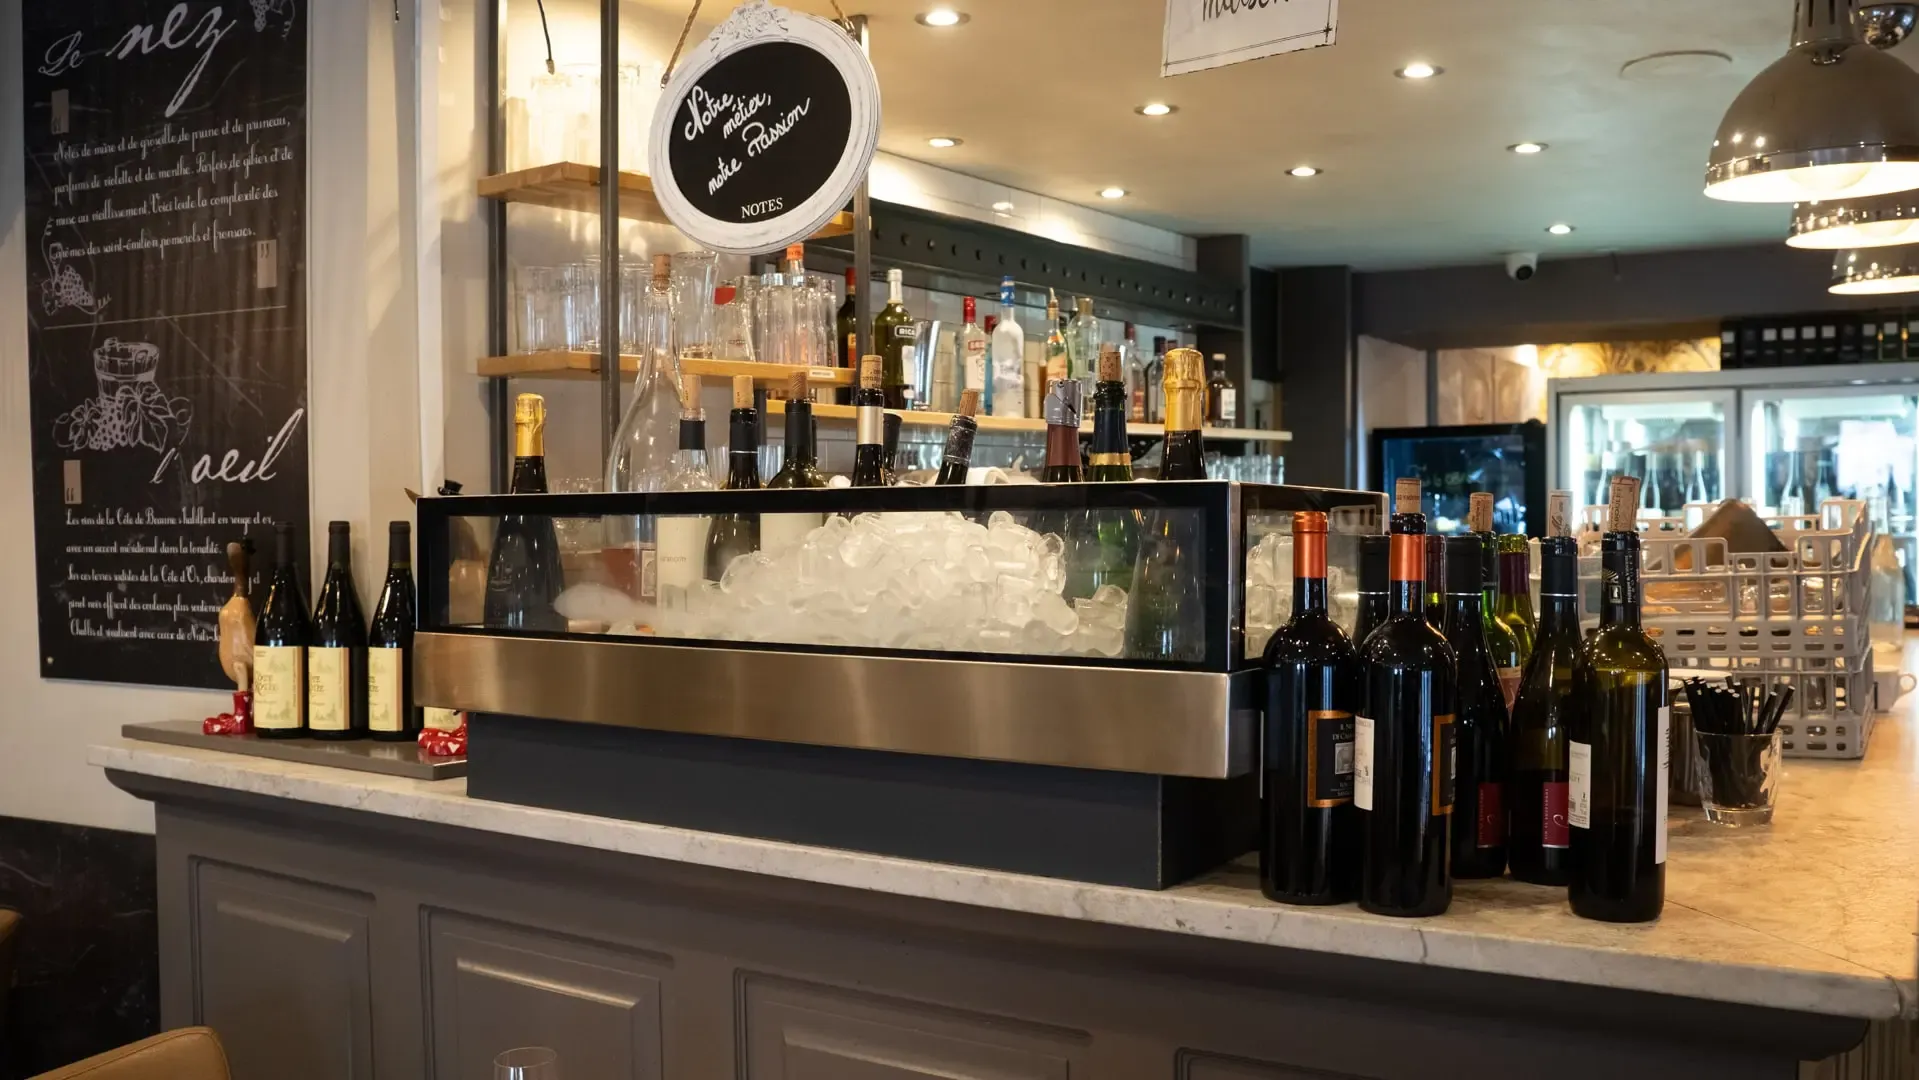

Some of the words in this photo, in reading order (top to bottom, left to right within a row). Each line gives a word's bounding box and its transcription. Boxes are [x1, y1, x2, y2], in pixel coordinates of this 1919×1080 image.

[38, 30, 84, 77] Le
[106, 2, 237, 118] nez
[684, 85, 735, 141] Notre
[722, 92, 771, 140] métier,
[232, 118, 244, 134] de
[708, 156, 742, 196] notre
[742, 97, 811, 158] Passion
[197, 186, 208, 208] la
[262, 184, 279, 199] des
[741, 197, 784, 219] NOTES
[898, 327, 916, 335] RICA
[66, 508, 79, 526] Les
[179, 535, 188, 554] la
